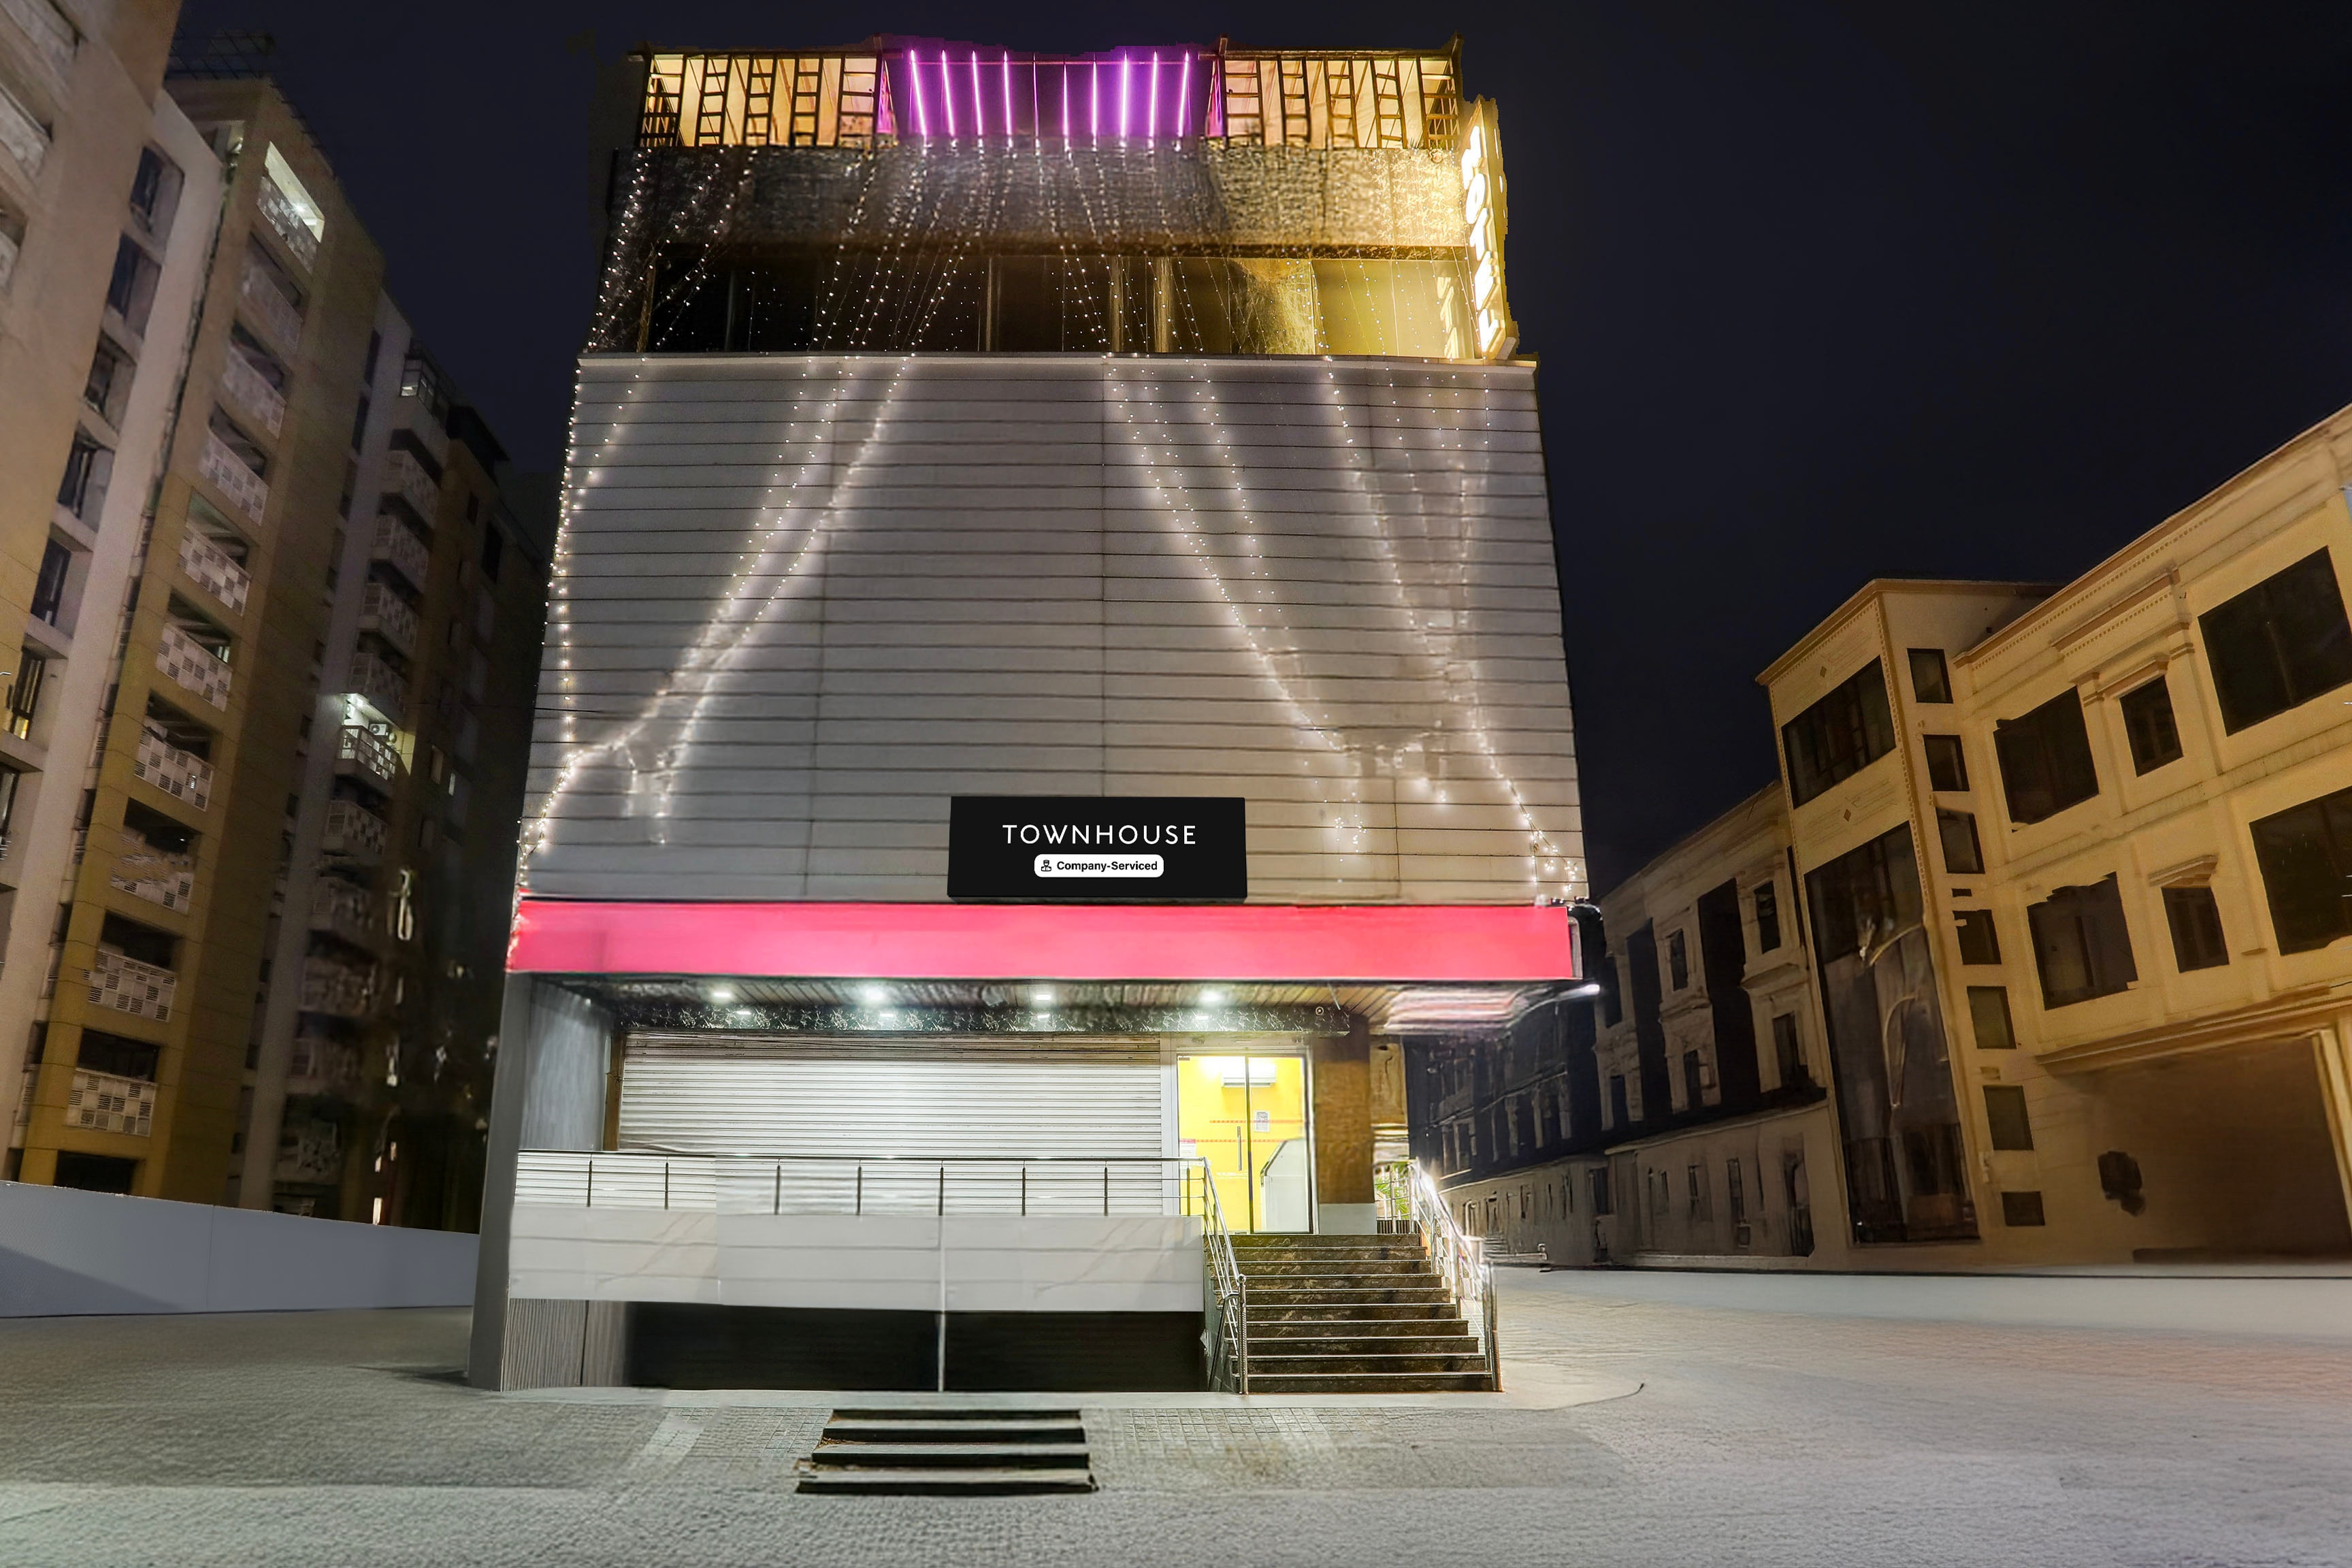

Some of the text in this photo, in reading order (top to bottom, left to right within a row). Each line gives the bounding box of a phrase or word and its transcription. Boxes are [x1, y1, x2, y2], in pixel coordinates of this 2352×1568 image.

[1461, 125, 1500, 353] HOTEL
[1002, 824, 1196, 845] TOWNHOUSE
[1056, 860, 1158, 872] Company-Serviced
